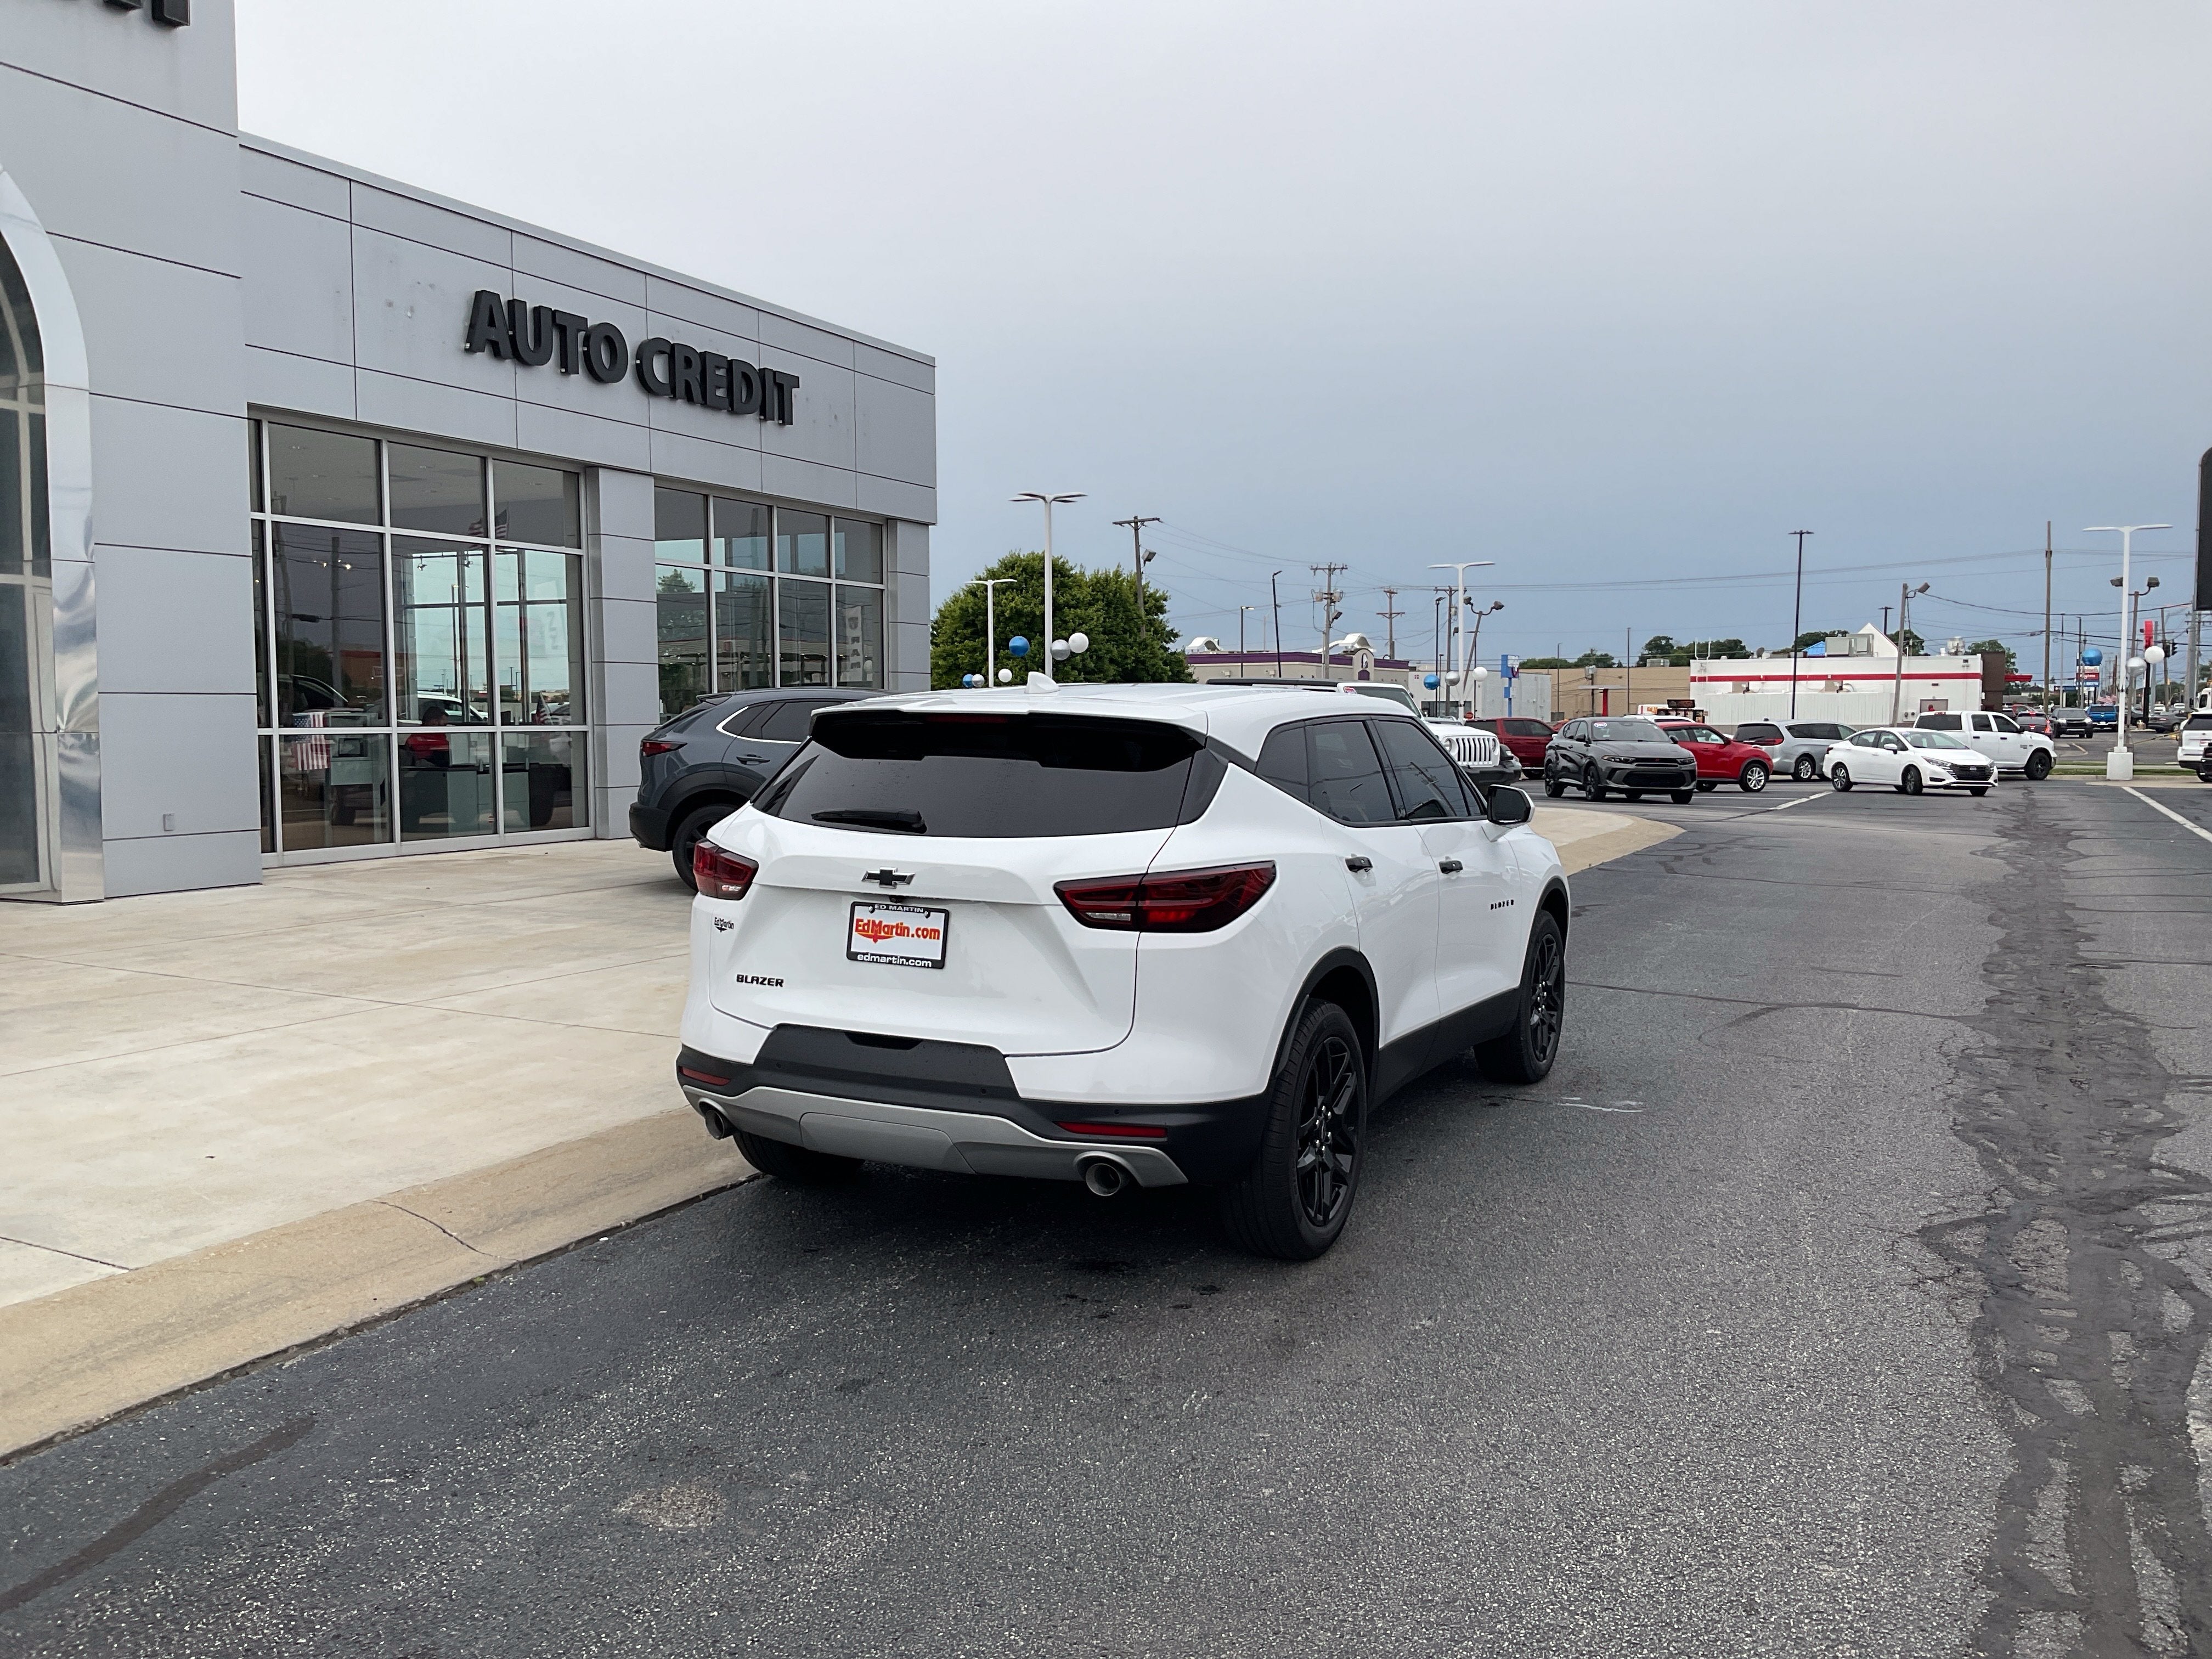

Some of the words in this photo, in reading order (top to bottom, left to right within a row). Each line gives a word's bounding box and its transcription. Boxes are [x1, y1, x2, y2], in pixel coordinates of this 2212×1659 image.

[466, 289, 629, 383] AUTO
[635, 337, 800, 426] CREDIT
[857, 952, 932, 968] edmartin.com
[736, 974, 784, 988] BLAZER
